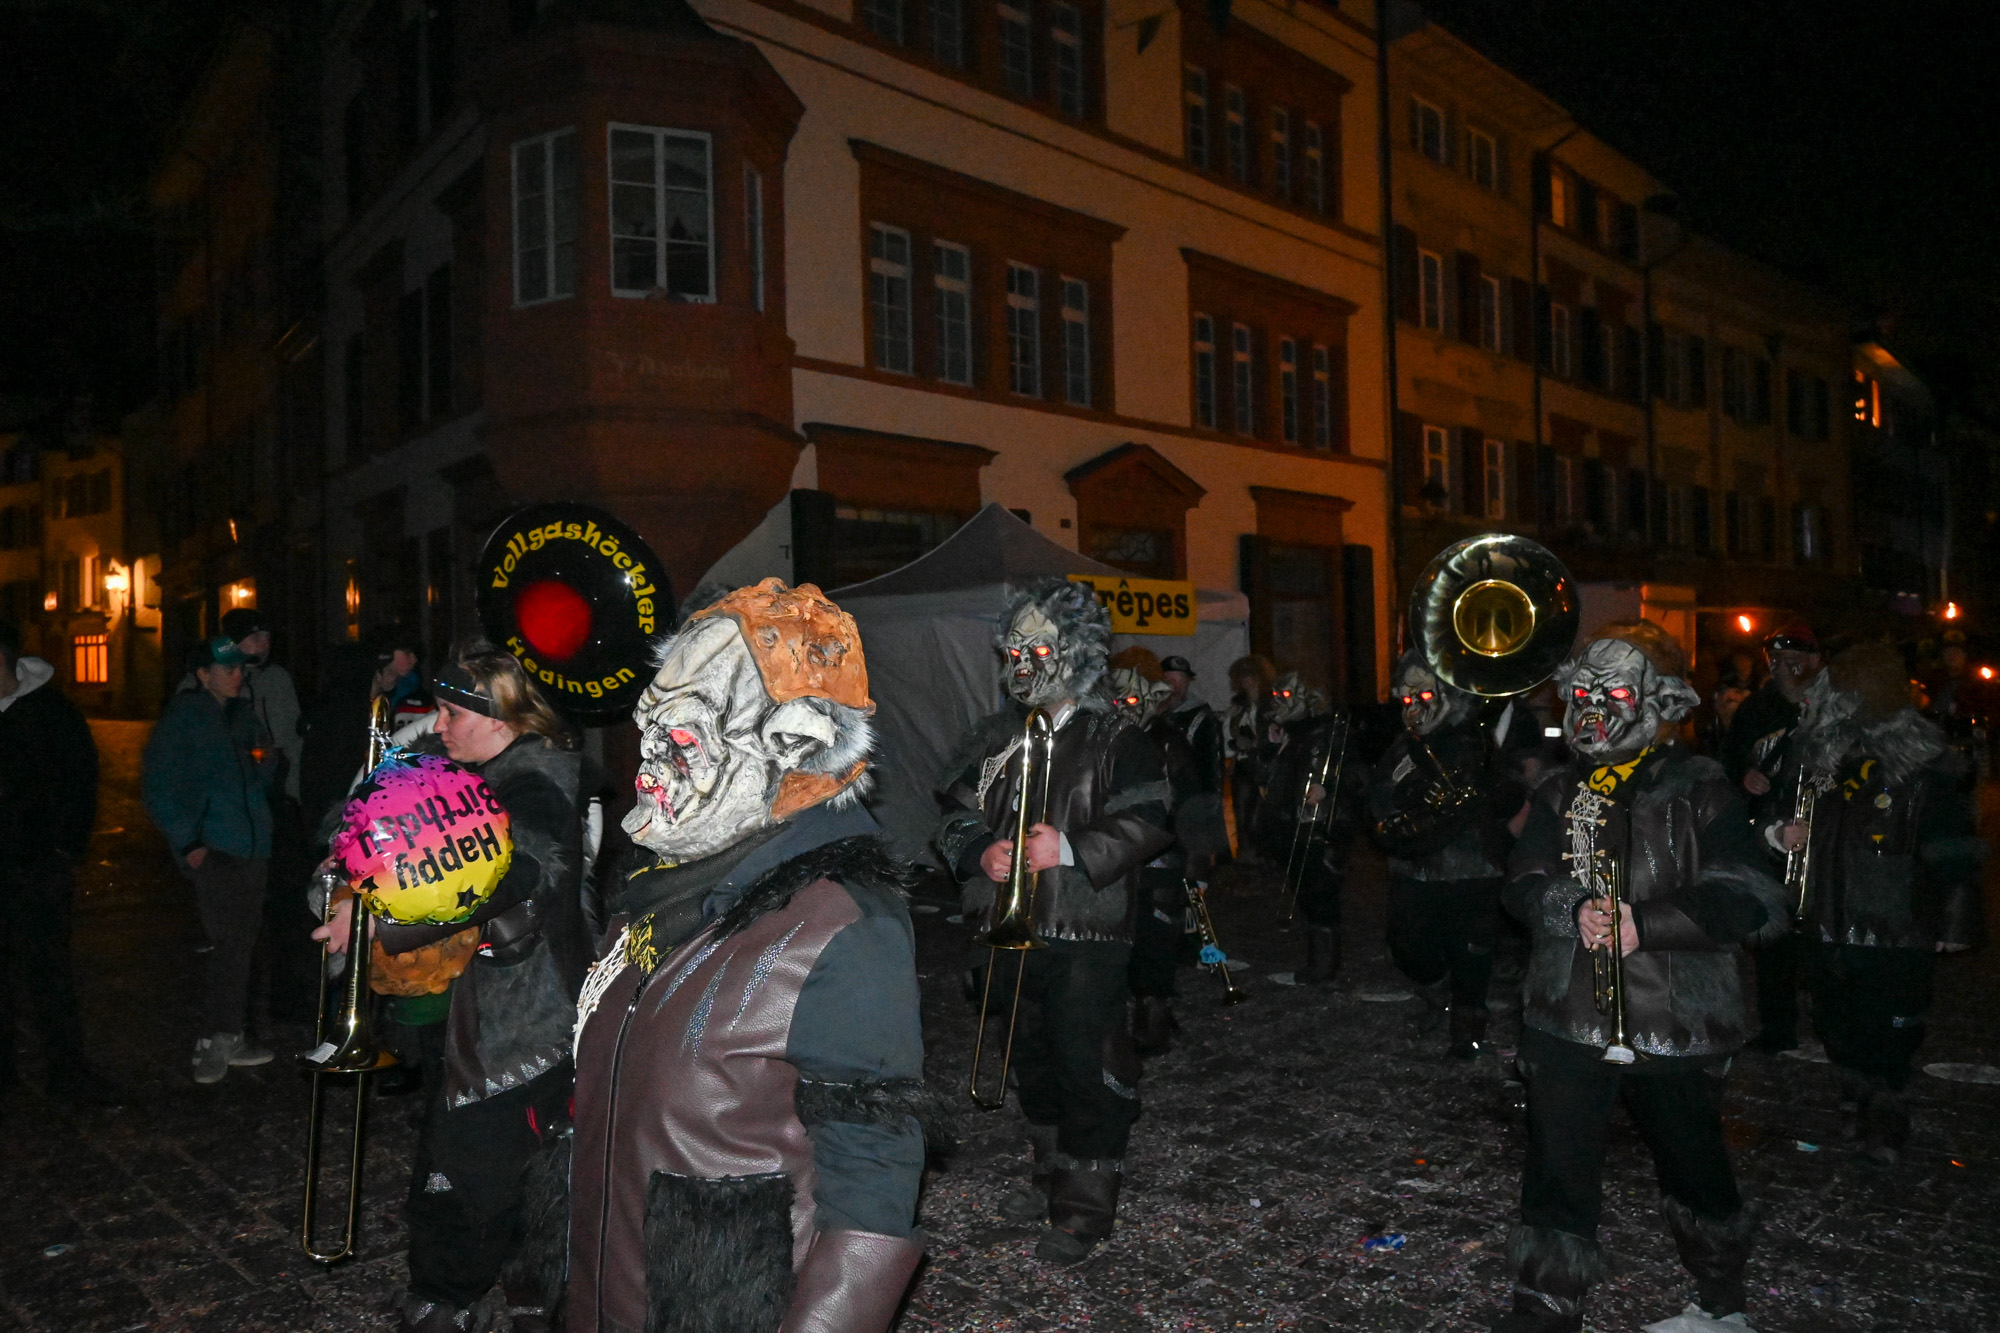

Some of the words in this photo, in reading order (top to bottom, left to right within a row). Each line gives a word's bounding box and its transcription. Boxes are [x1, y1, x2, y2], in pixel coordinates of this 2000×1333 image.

[492, 520, 656, 634] Vollgashöckler
[1081, 579, 1190, 627] rêpes
[506, 636, 636, 698] Hedingen
[395, 822, 502, 890] Happy
